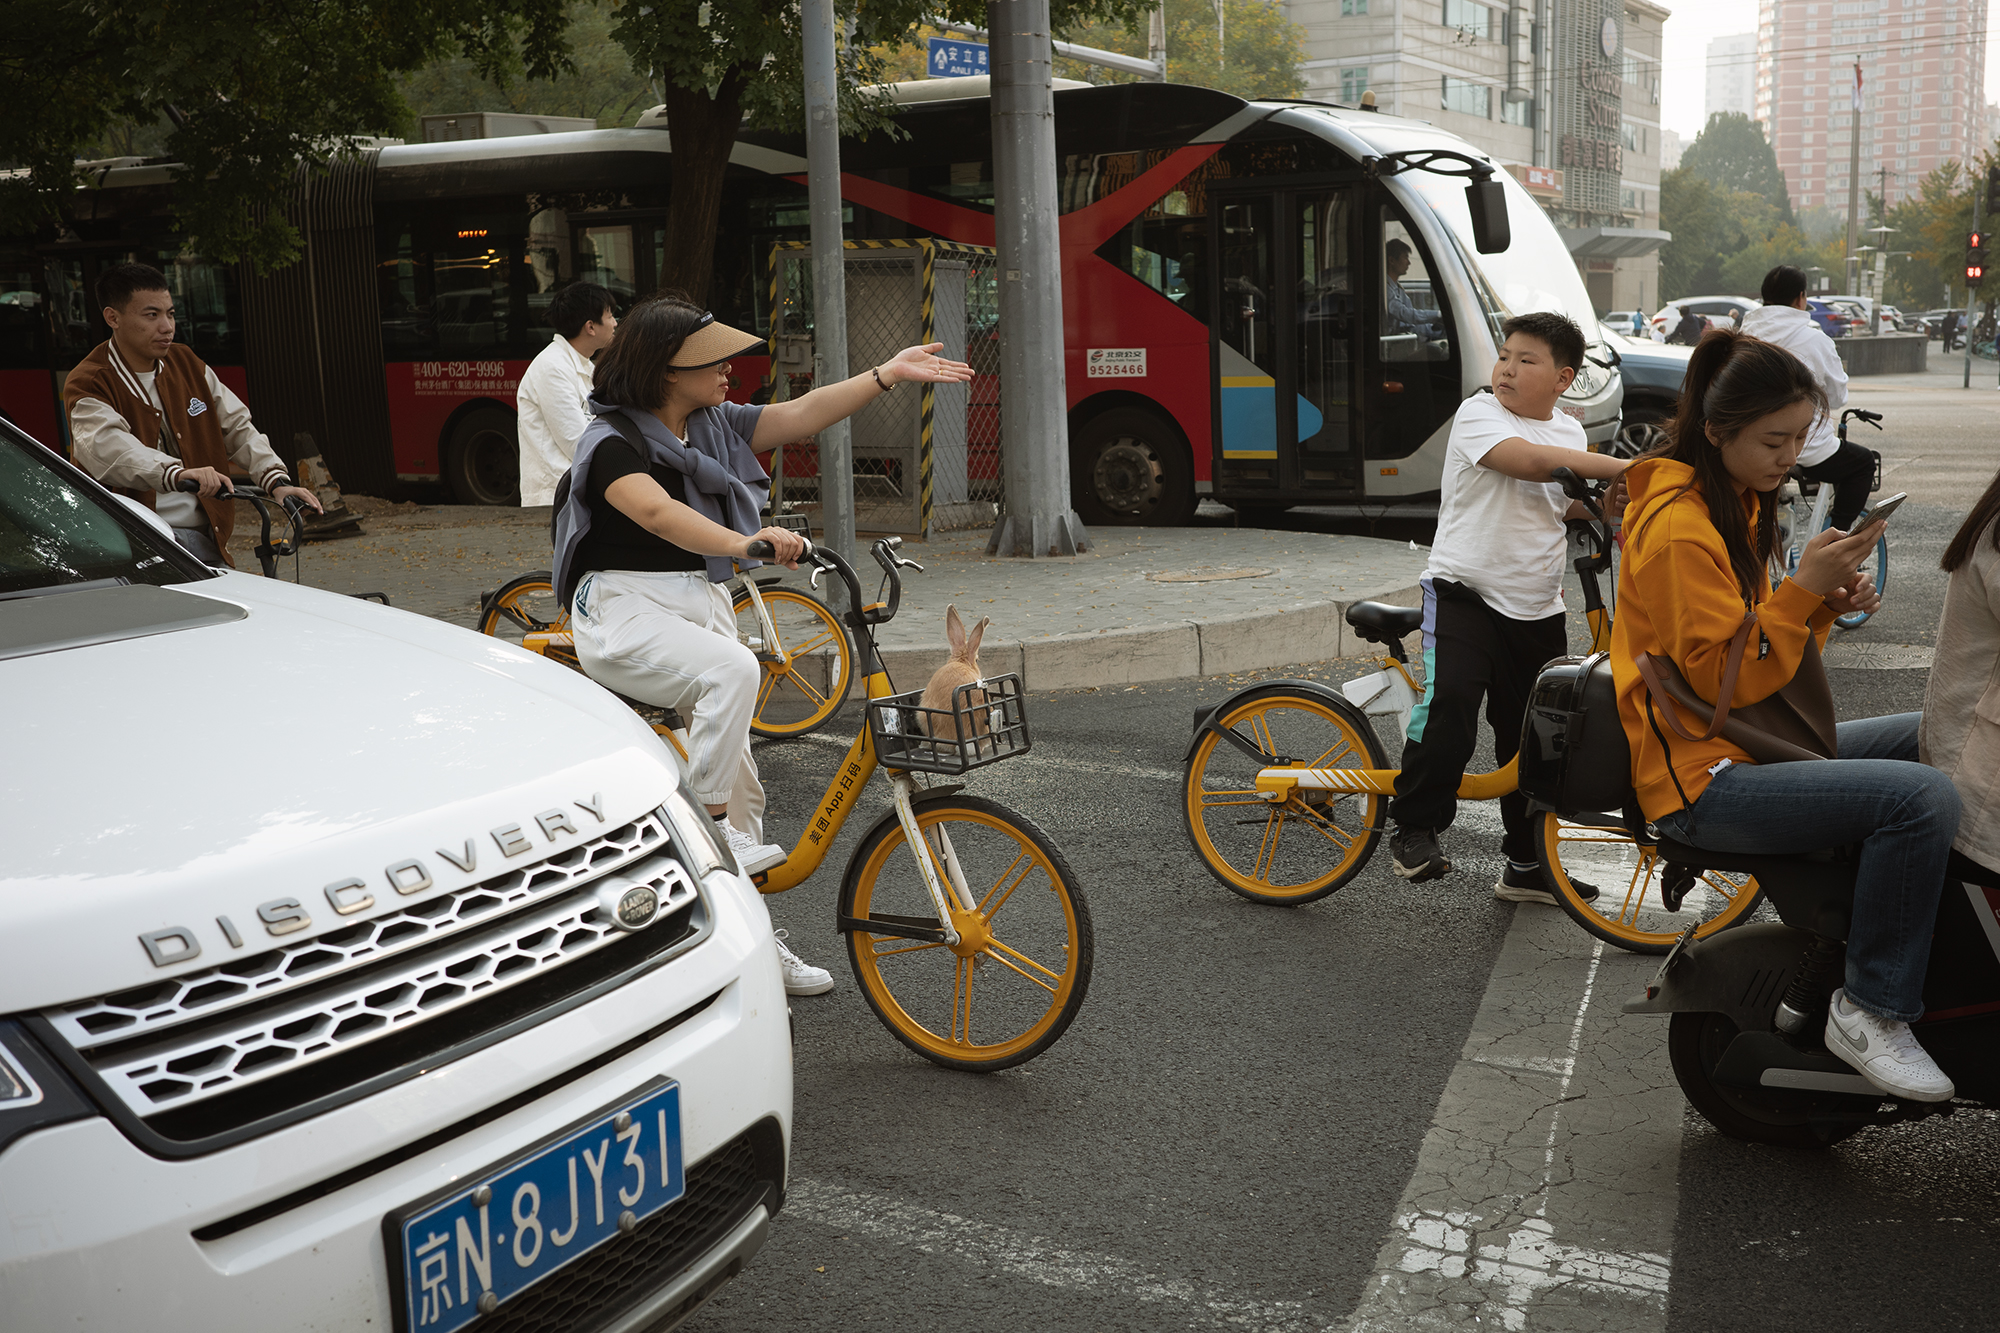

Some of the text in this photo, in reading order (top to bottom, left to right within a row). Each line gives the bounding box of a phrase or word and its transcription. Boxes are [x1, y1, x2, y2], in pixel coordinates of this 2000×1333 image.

[948, 47, 987, 65] 安立路
[421, 361, 505, 377] 400-620-9996
[1090, 364, 1144, 376] 9525466
[809, 761, 862, 846] 美团 App 扫码
[138, 792, 605, 968] DISCOVERY
[623, 893, 645, 912] LAND
[630, 900, 655, 920] ROVER
[415, 1109, 669, 1327] 京N·8JY31
